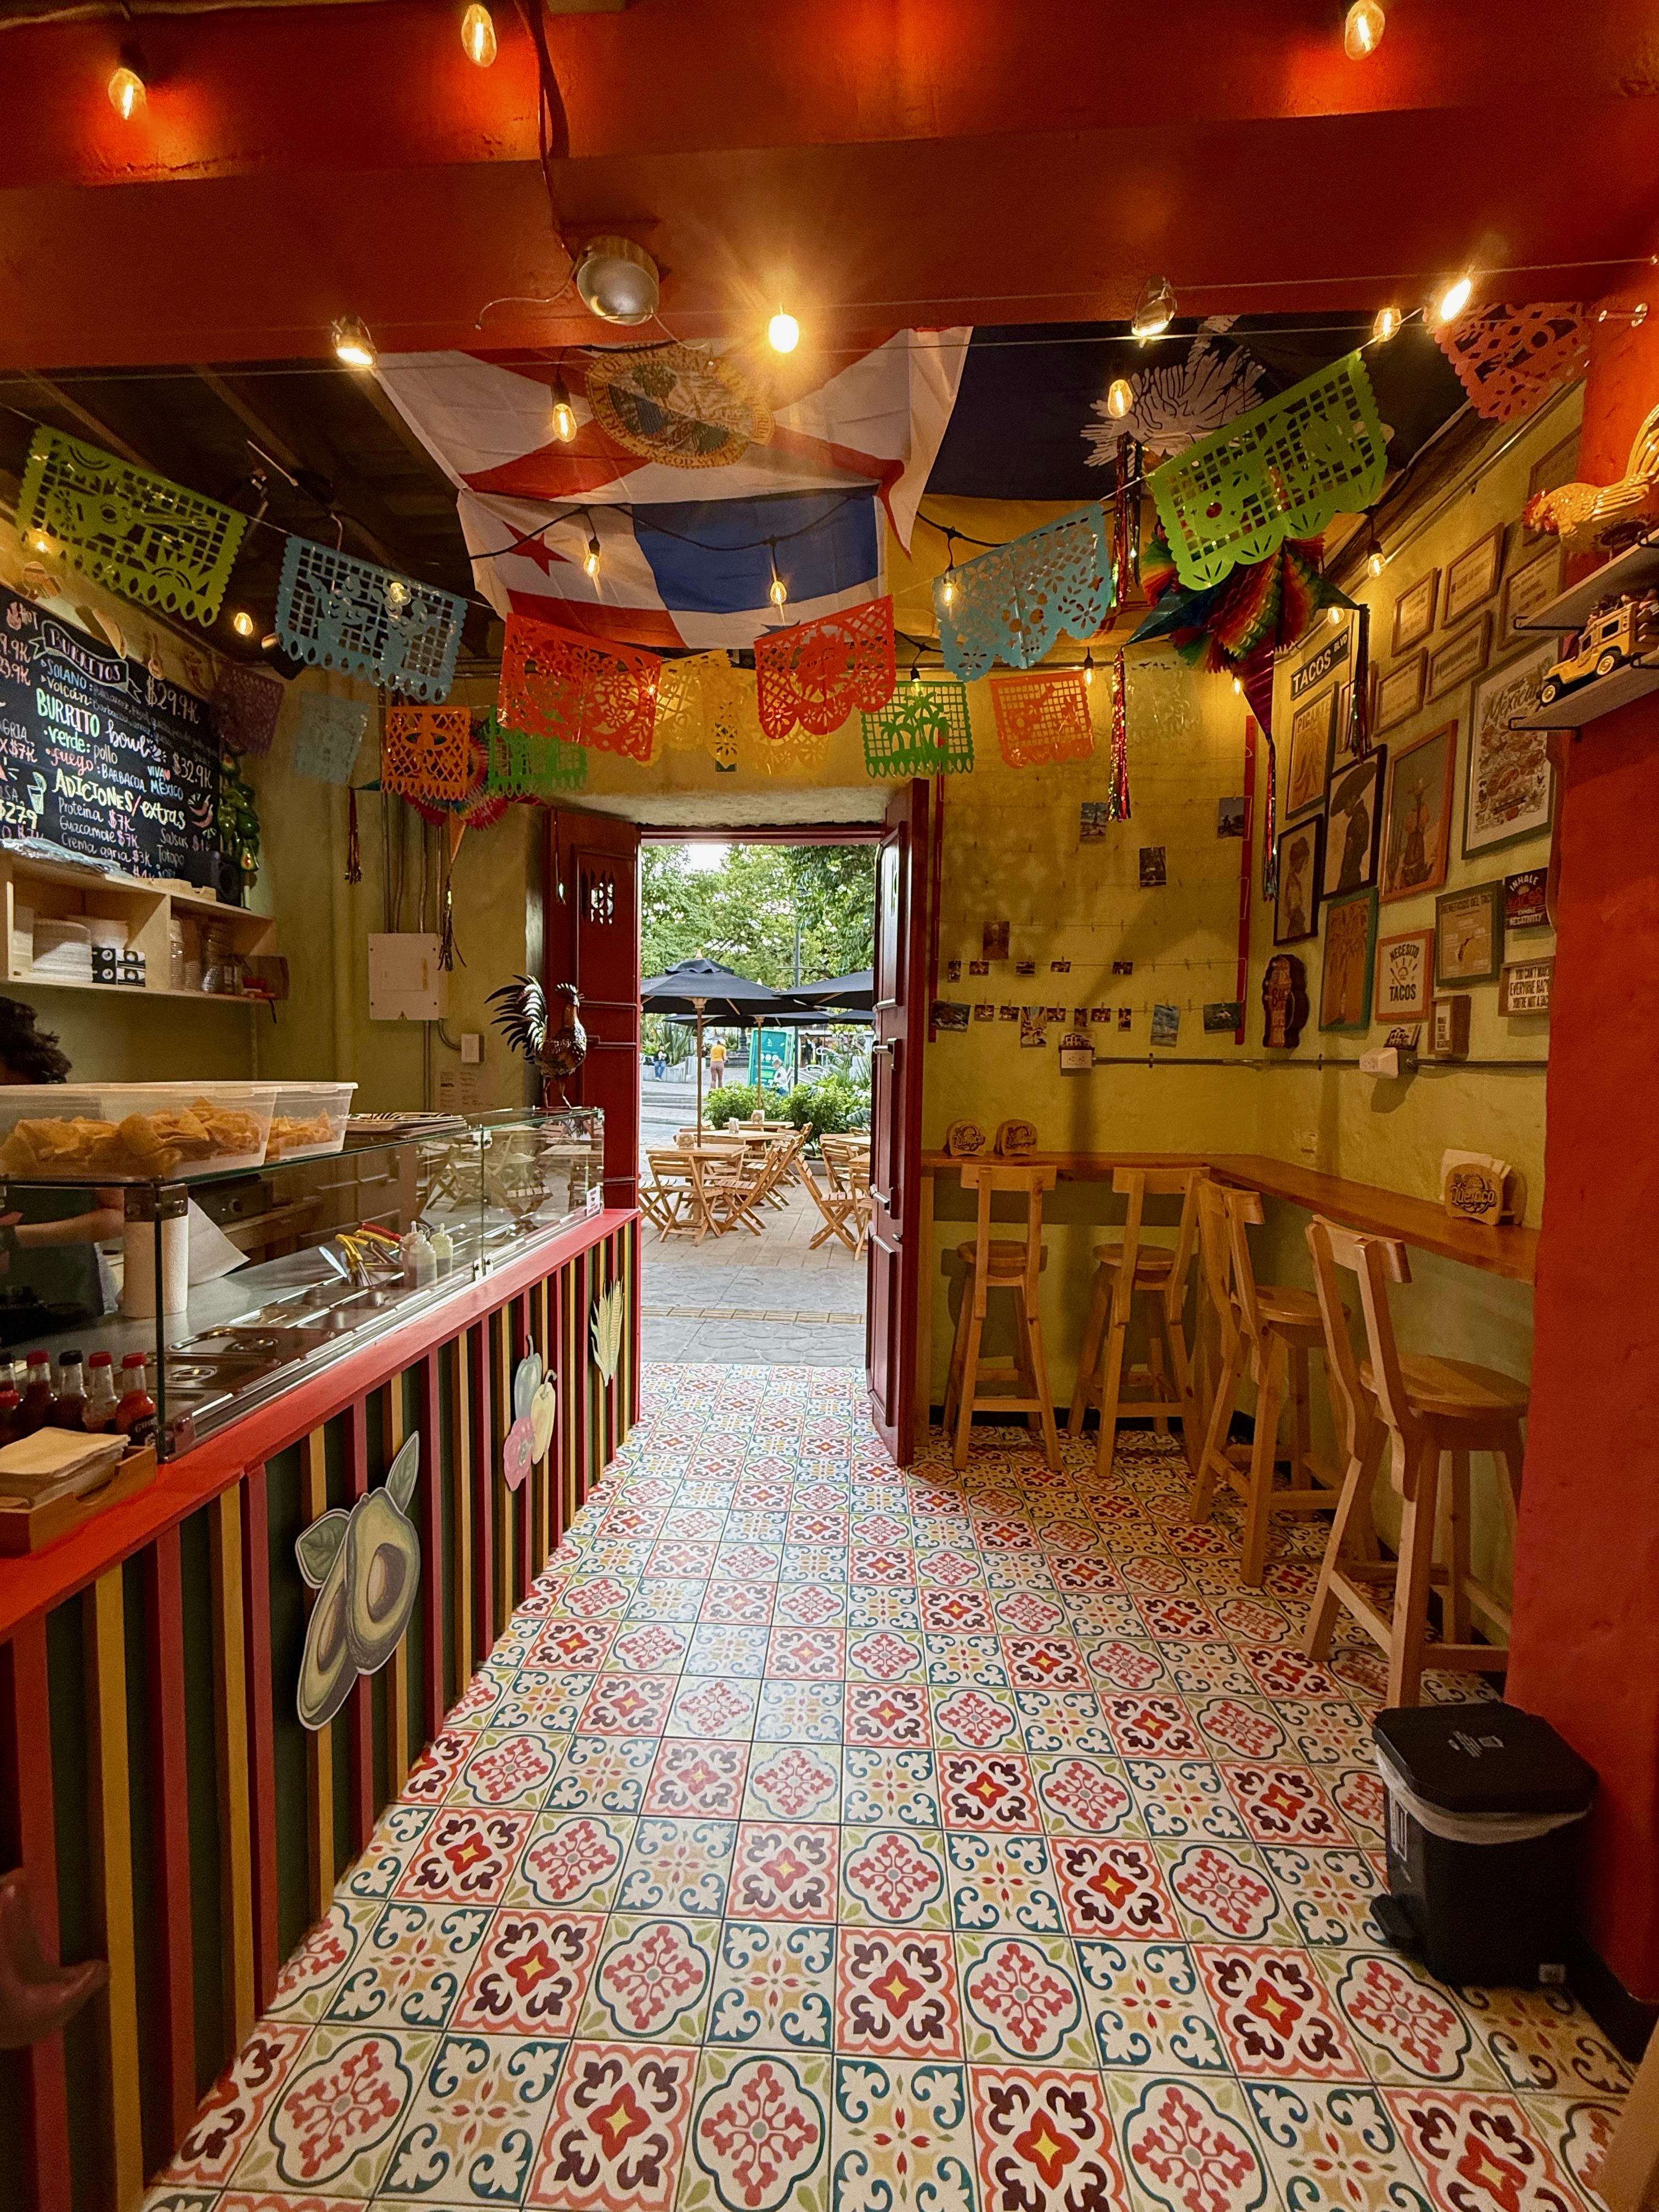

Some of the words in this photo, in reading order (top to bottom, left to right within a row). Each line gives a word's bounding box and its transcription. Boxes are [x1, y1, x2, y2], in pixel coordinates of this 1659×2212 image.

[50, 629, 120, 681] BURRITOS
[1293, 649, 1331, 693] TACOS
[1334, 634, 1347, 652] BLVD
[36, 687, 100, 737] BURRITO
[147, 765, 165, 778] VIVA
[1509, 874, 1539, 891] INHALE
[1390, 944, 1420, 962] NECESITO
[1390, 984, 1417, 1002] TACOS
